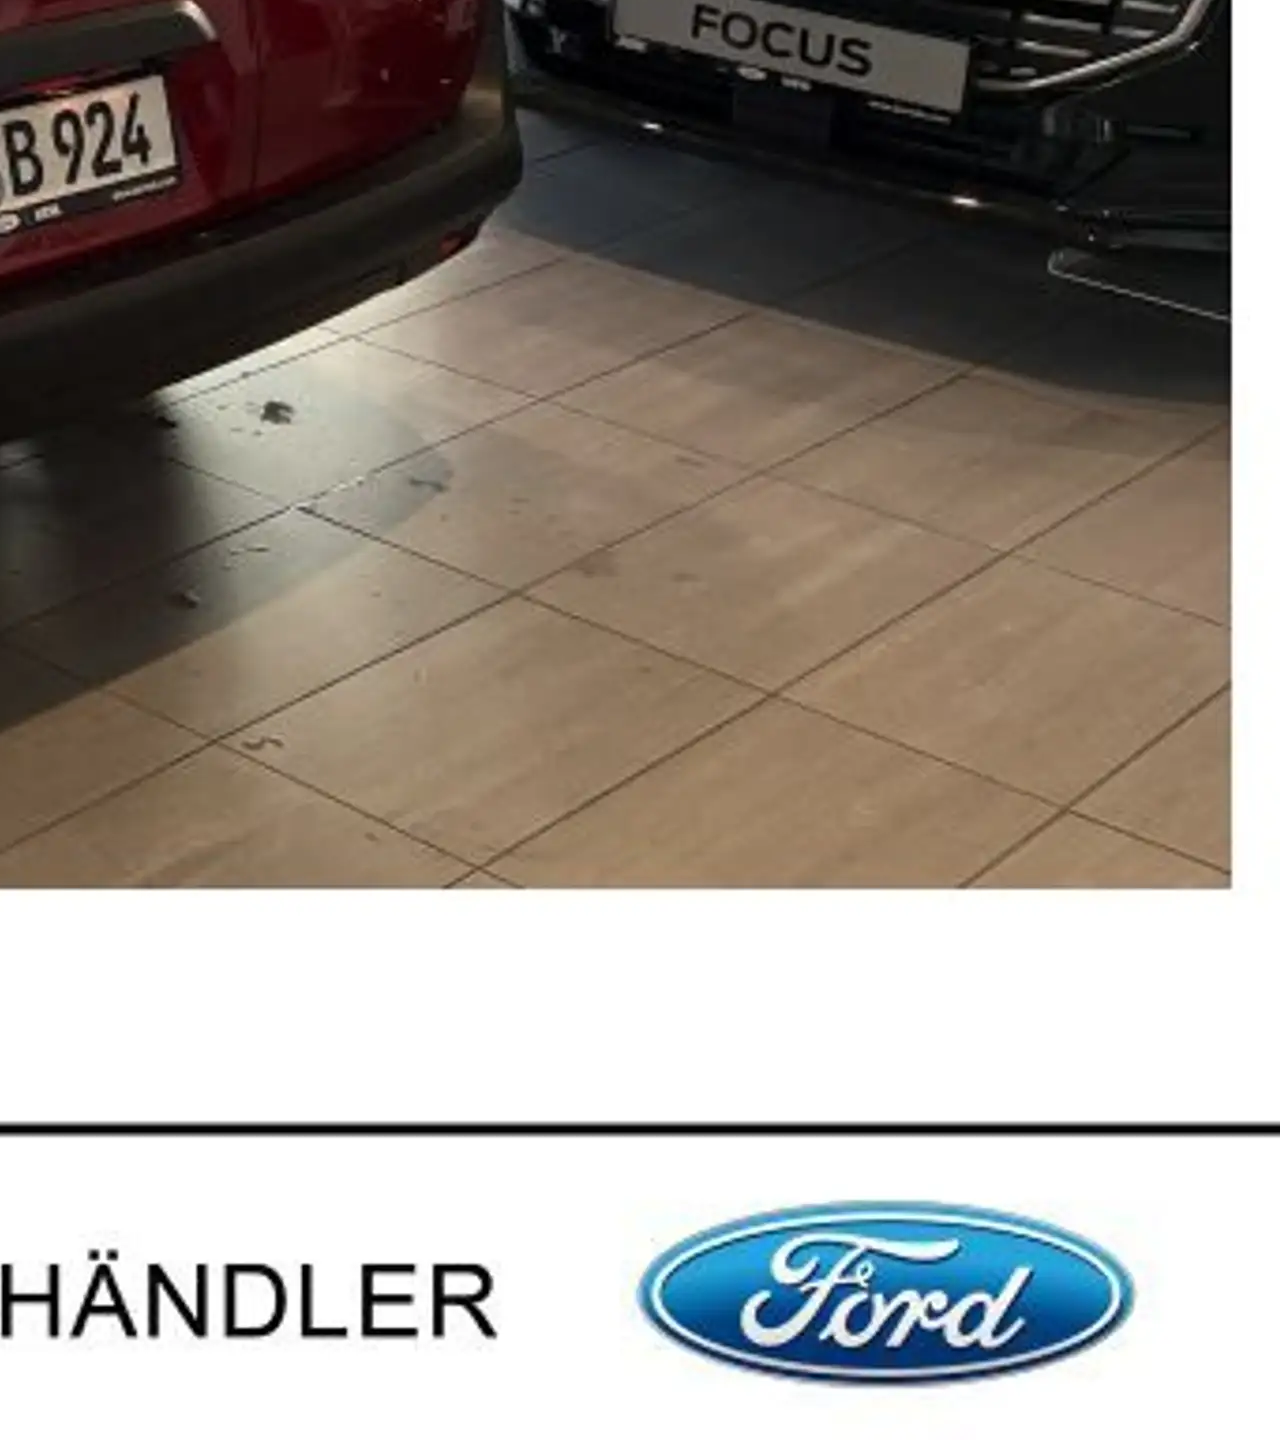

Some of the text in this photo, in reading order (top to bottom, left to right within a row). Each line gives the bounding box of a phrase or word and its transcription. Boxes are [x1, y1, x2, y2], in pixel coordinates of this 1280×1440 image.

[691, 3, 873, 77] FOCUS
[4, 118, 44, 197] B
[52, 92, 152, 185] 924
